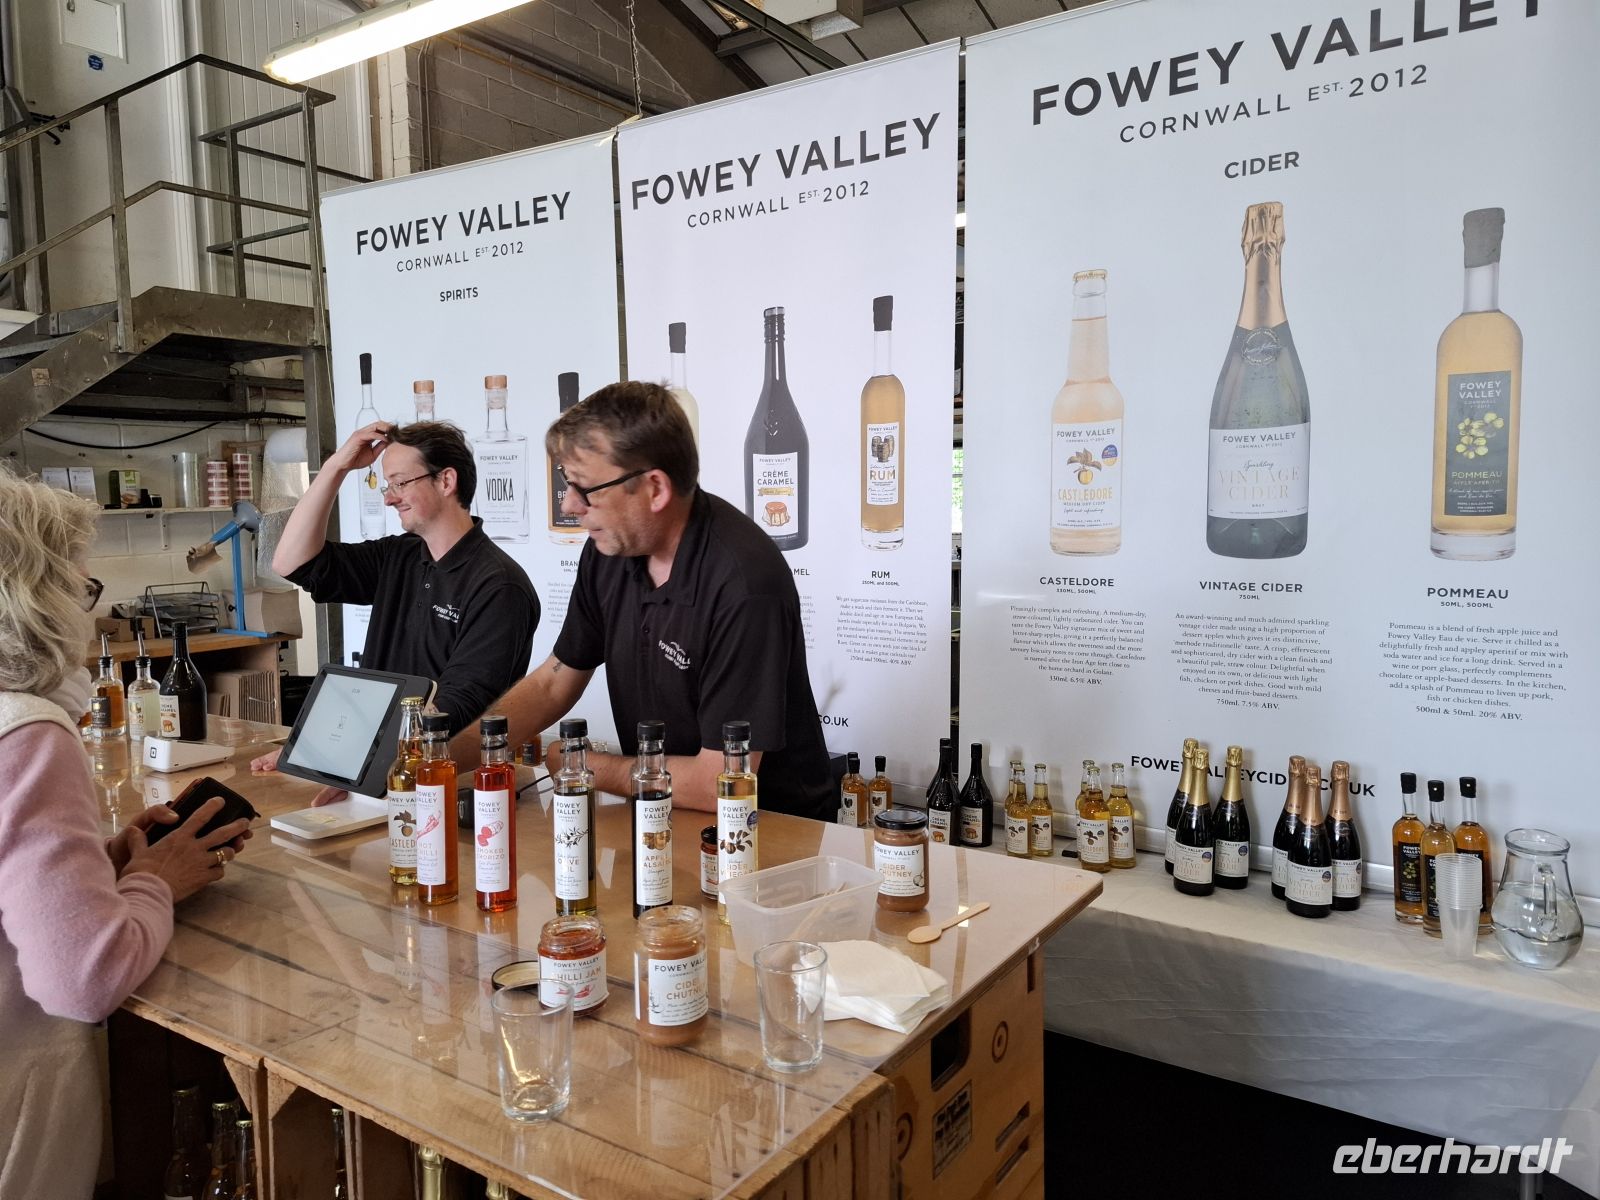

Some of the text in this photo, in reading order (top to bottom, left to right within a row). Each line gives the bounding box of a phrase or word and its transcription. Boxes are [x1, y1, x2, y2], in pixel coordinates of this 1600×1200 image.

[1033, 40, 1245, 126] FOWEY
[1120, 94, 1291, 143] CORNWALL
[1348, 63, 1428, 98] 2012
[632, 112, 940, 210] FOWEY VALLEY
[1224, 150, 1300, 180] CIDER
[687, 196, 789, 228] CORNWALL
[823, 180, 869, 202] 2012
[356, 191, 570, 255] FOWEY VALLEY
[396, 250, 469, 272] CORNWALL
[492, 241, 524, 257] 2012
[440, 287, 479, 302] SPIRITS
[1459, 381, 1501, 391] FOWEY
[1459, 389, 1501, 399] VALLEY
[1223, 431, 1296, 443] FOWEY VALLEY
[762, 469, 789, 478] CRÈME
[869, 470, 896, 481] RUM
[1451, 471, 1503, 479] POMMEAU
[757, 477, 794, 486] CARAMEL
[485, 478, 514, 501] VODKA
[871, 571, 890, 579] RUM
[1039, 576, 1115, 587] CASTELDORE
[1199, 581, 1303, 593] VINTAGE CIDER
[1427, 587, 1509, 600] POMMEAU
[1440, 601, 1465, 609] 50ML,
[1389, 621, 1426, 630] Pommeau
[1427, 623, 1434, 631] is
[1441, 624, 1464, 632] blend
[1465, 625, 1474, 633] of
[1475, 625, 1495, 633] fresh
[1496, 626, 1518, 636] apple
[1520, 627, 1540, 637] juice
[1542, 628, 1558, 636] and
[1387, 631, 1410, 642] Fowey
[1413, 633, 1436, 643] Valley
[1438, 634, 1453, 642] Eau
[1454, 635, 1464, 643] de
[1481, 636, 1503, 644] Serve
[1505, 637, 1512, 645] it
[1513, 637, 1542, 646] chilled
[1424, 643, 1443, 652] fresh
[1444, 644, 1459, 653] and
[1460, 645, 1486, 656] appley
[1488, 647, 1517, 658] aperitif
[1530, 649, 1546, 657] mix
[1548, 650, 1568, 658] with
[1383, 651, 1399, 659] soda
[1401, 652, 1421, 661] water
[1423, 653, 1438, 662] and
[1439, 654, 1450, 662] ice
[1451, 655, 1463, 663] for
[1471, 656, 1489, 666] long
[1517, 659, 1545, 668] Served
[1547, 660, 1555, 668] in
[1392, 662, 1410, 670] wine
[1421, 663, 1437, 674] port
[1506, 679, 1515, 687] In
[1517, 679, 1530, 688] the
[1389, 681, 1403, 689] add
[1410, 682, 1434, 694] splash
[1435, 684, 1443, 692] of
[1445, 685, 1484, 695] Pommeau
[1485, 687, 1494, 696] to
[1496, 688, 1516, 697] liven
[1518, 692, 1529, 700] up
[1426, 694, 1441, 702] fish
[1452, 696, 1483, 705] chicken
[1416, 705, 1441, 714] 500ml
[1442, 707, 1450, 715] &
[1478, 709, 1497, 718] 20%
[644, 805, 669, 813] FOWEY
[644, 812, 669, 820] VALLEY
[579, 957, 600, 967] VALLEY
[654, 963, 688, 972] FOWEY
